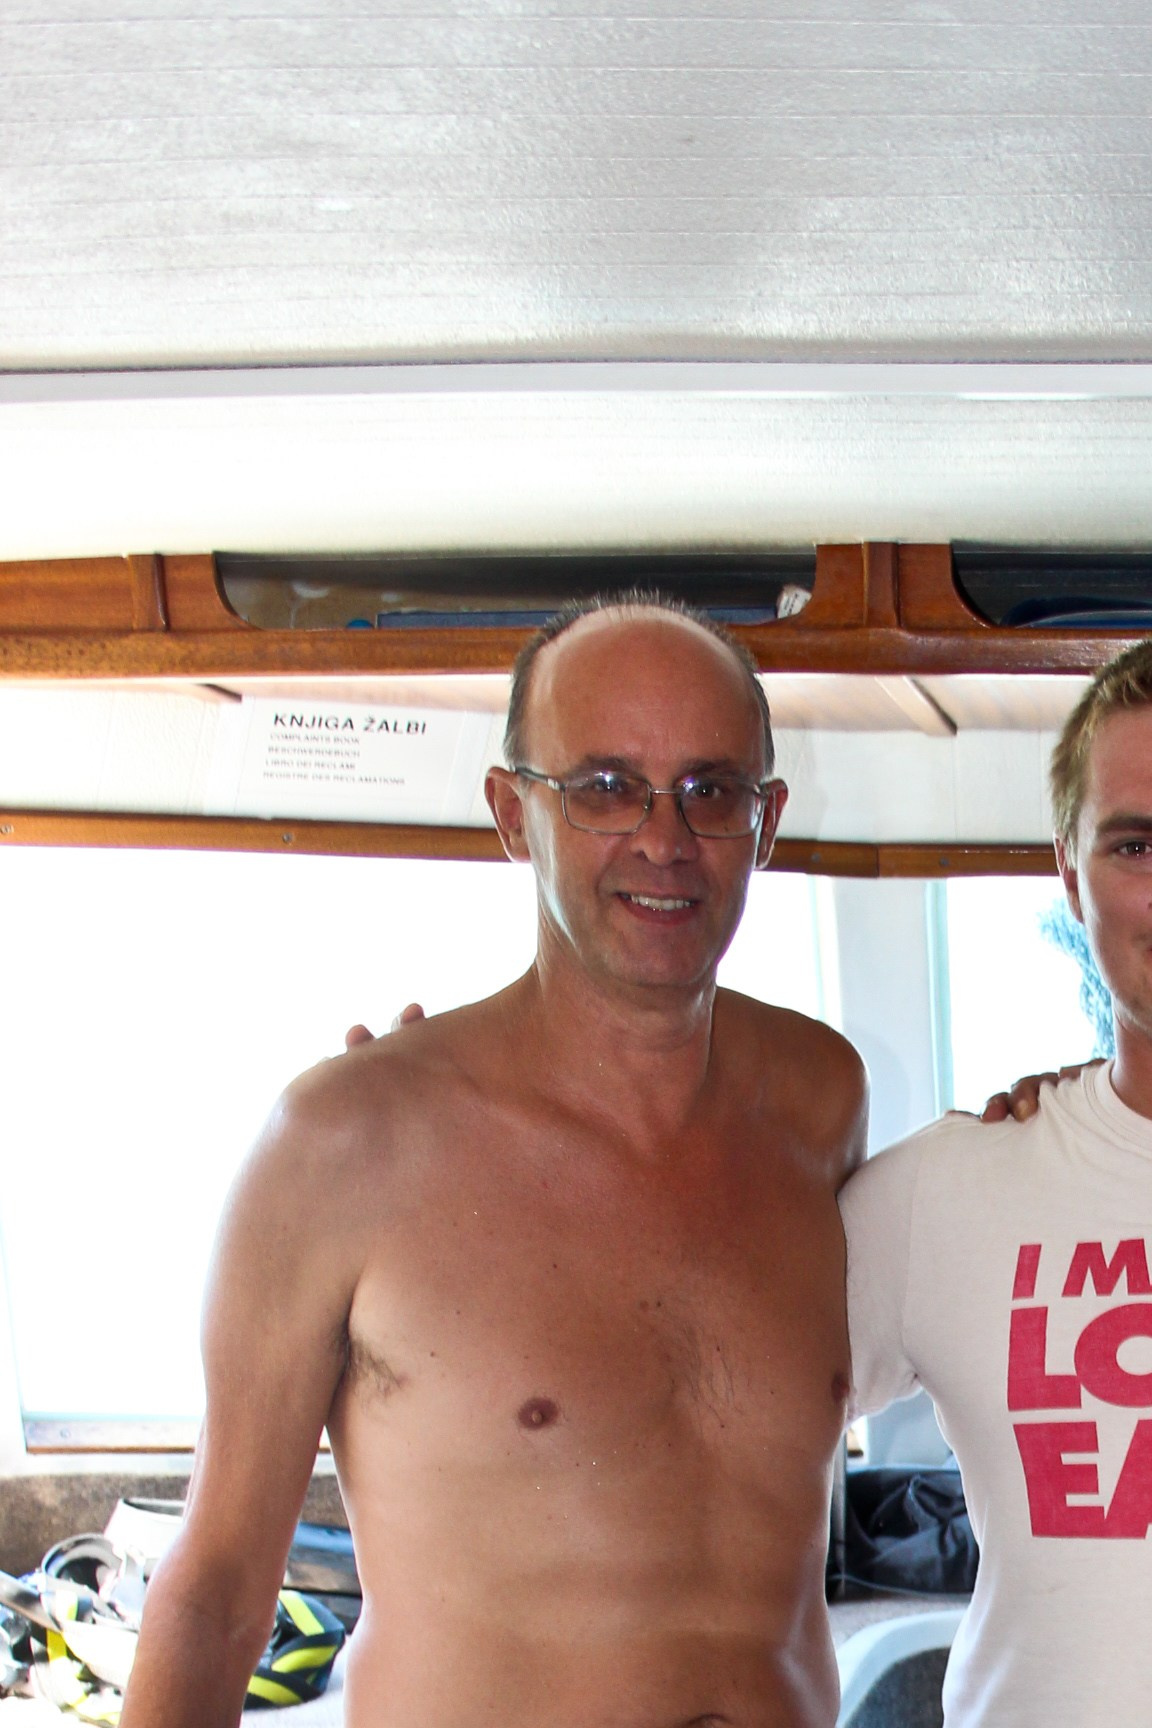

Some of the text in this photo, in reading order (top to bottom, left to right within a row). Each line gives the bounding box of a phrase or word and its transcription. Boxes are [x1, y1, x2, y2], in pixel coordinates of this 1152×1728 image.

[273, 713, 427, 735] KNJIGA ŽALBI
[1012, 1243, 1042, 1301] I
